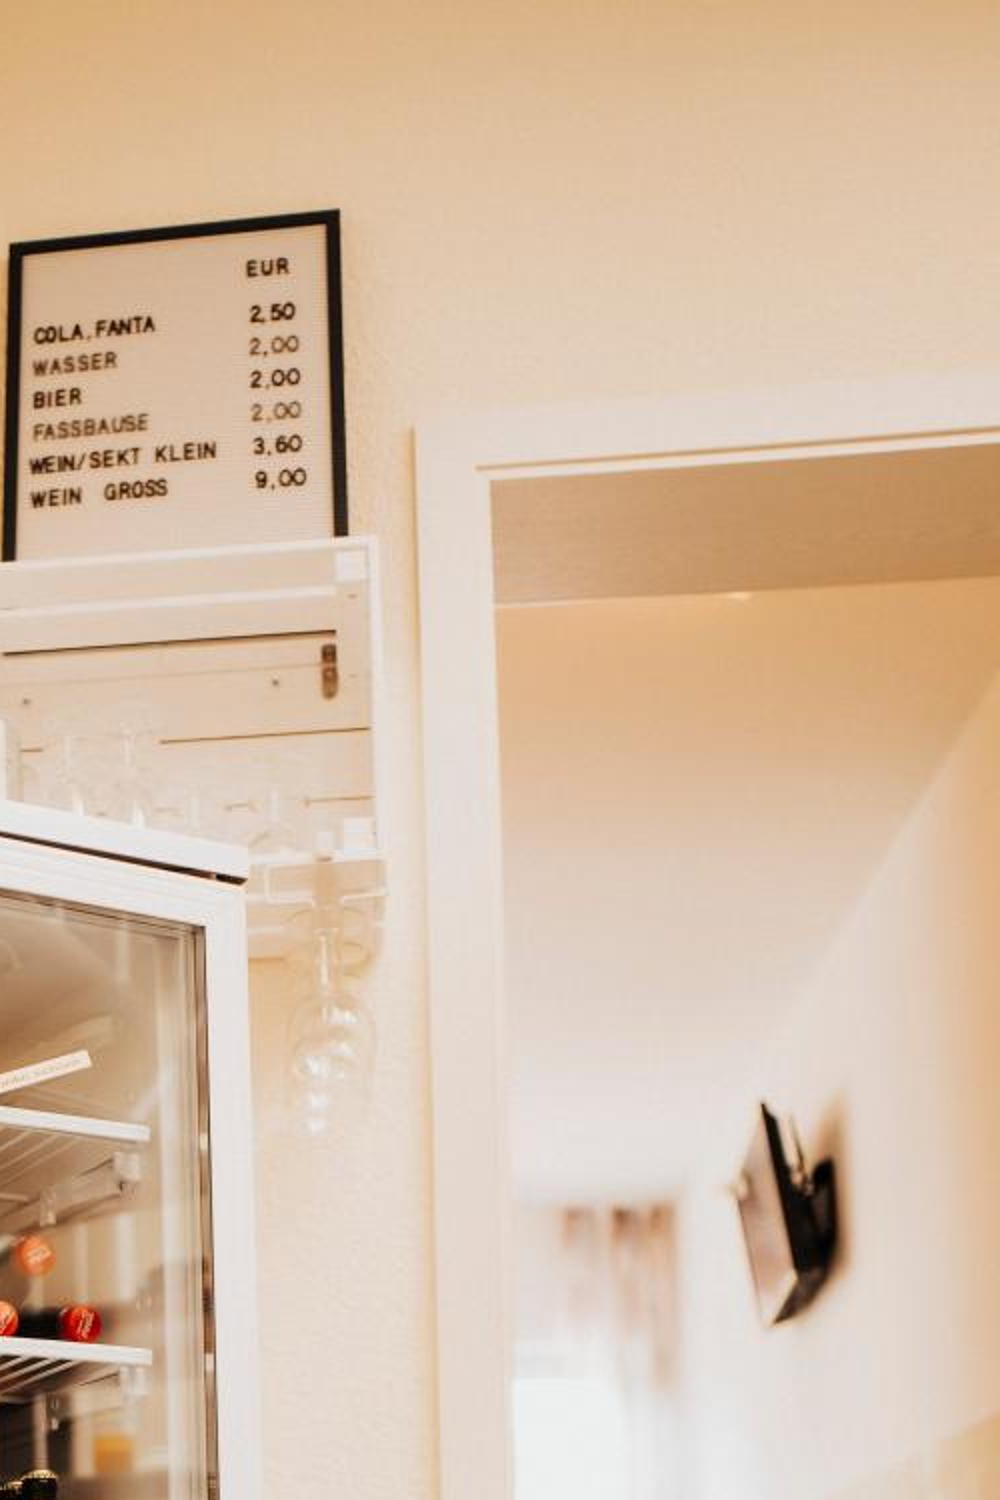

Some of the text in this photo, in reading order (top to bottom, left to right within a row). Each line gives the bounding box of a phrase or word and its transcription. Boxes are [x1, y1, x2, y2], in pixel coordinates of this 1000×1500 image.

[246, 257, 290, 278] EUR
[250, 302, 297, 324] 2,50
[32, 335, 300, 377] WASSER 2,00
[33, 368, 301, 410] BIER 2,00
[33, 401, 302, 441] FASSBAUSE 2,00
[29, 434, 303, 475] WEIN/SEKT KLEIN 3,60
[30, 467, 307, 508] WEIN GROSS 9,00
